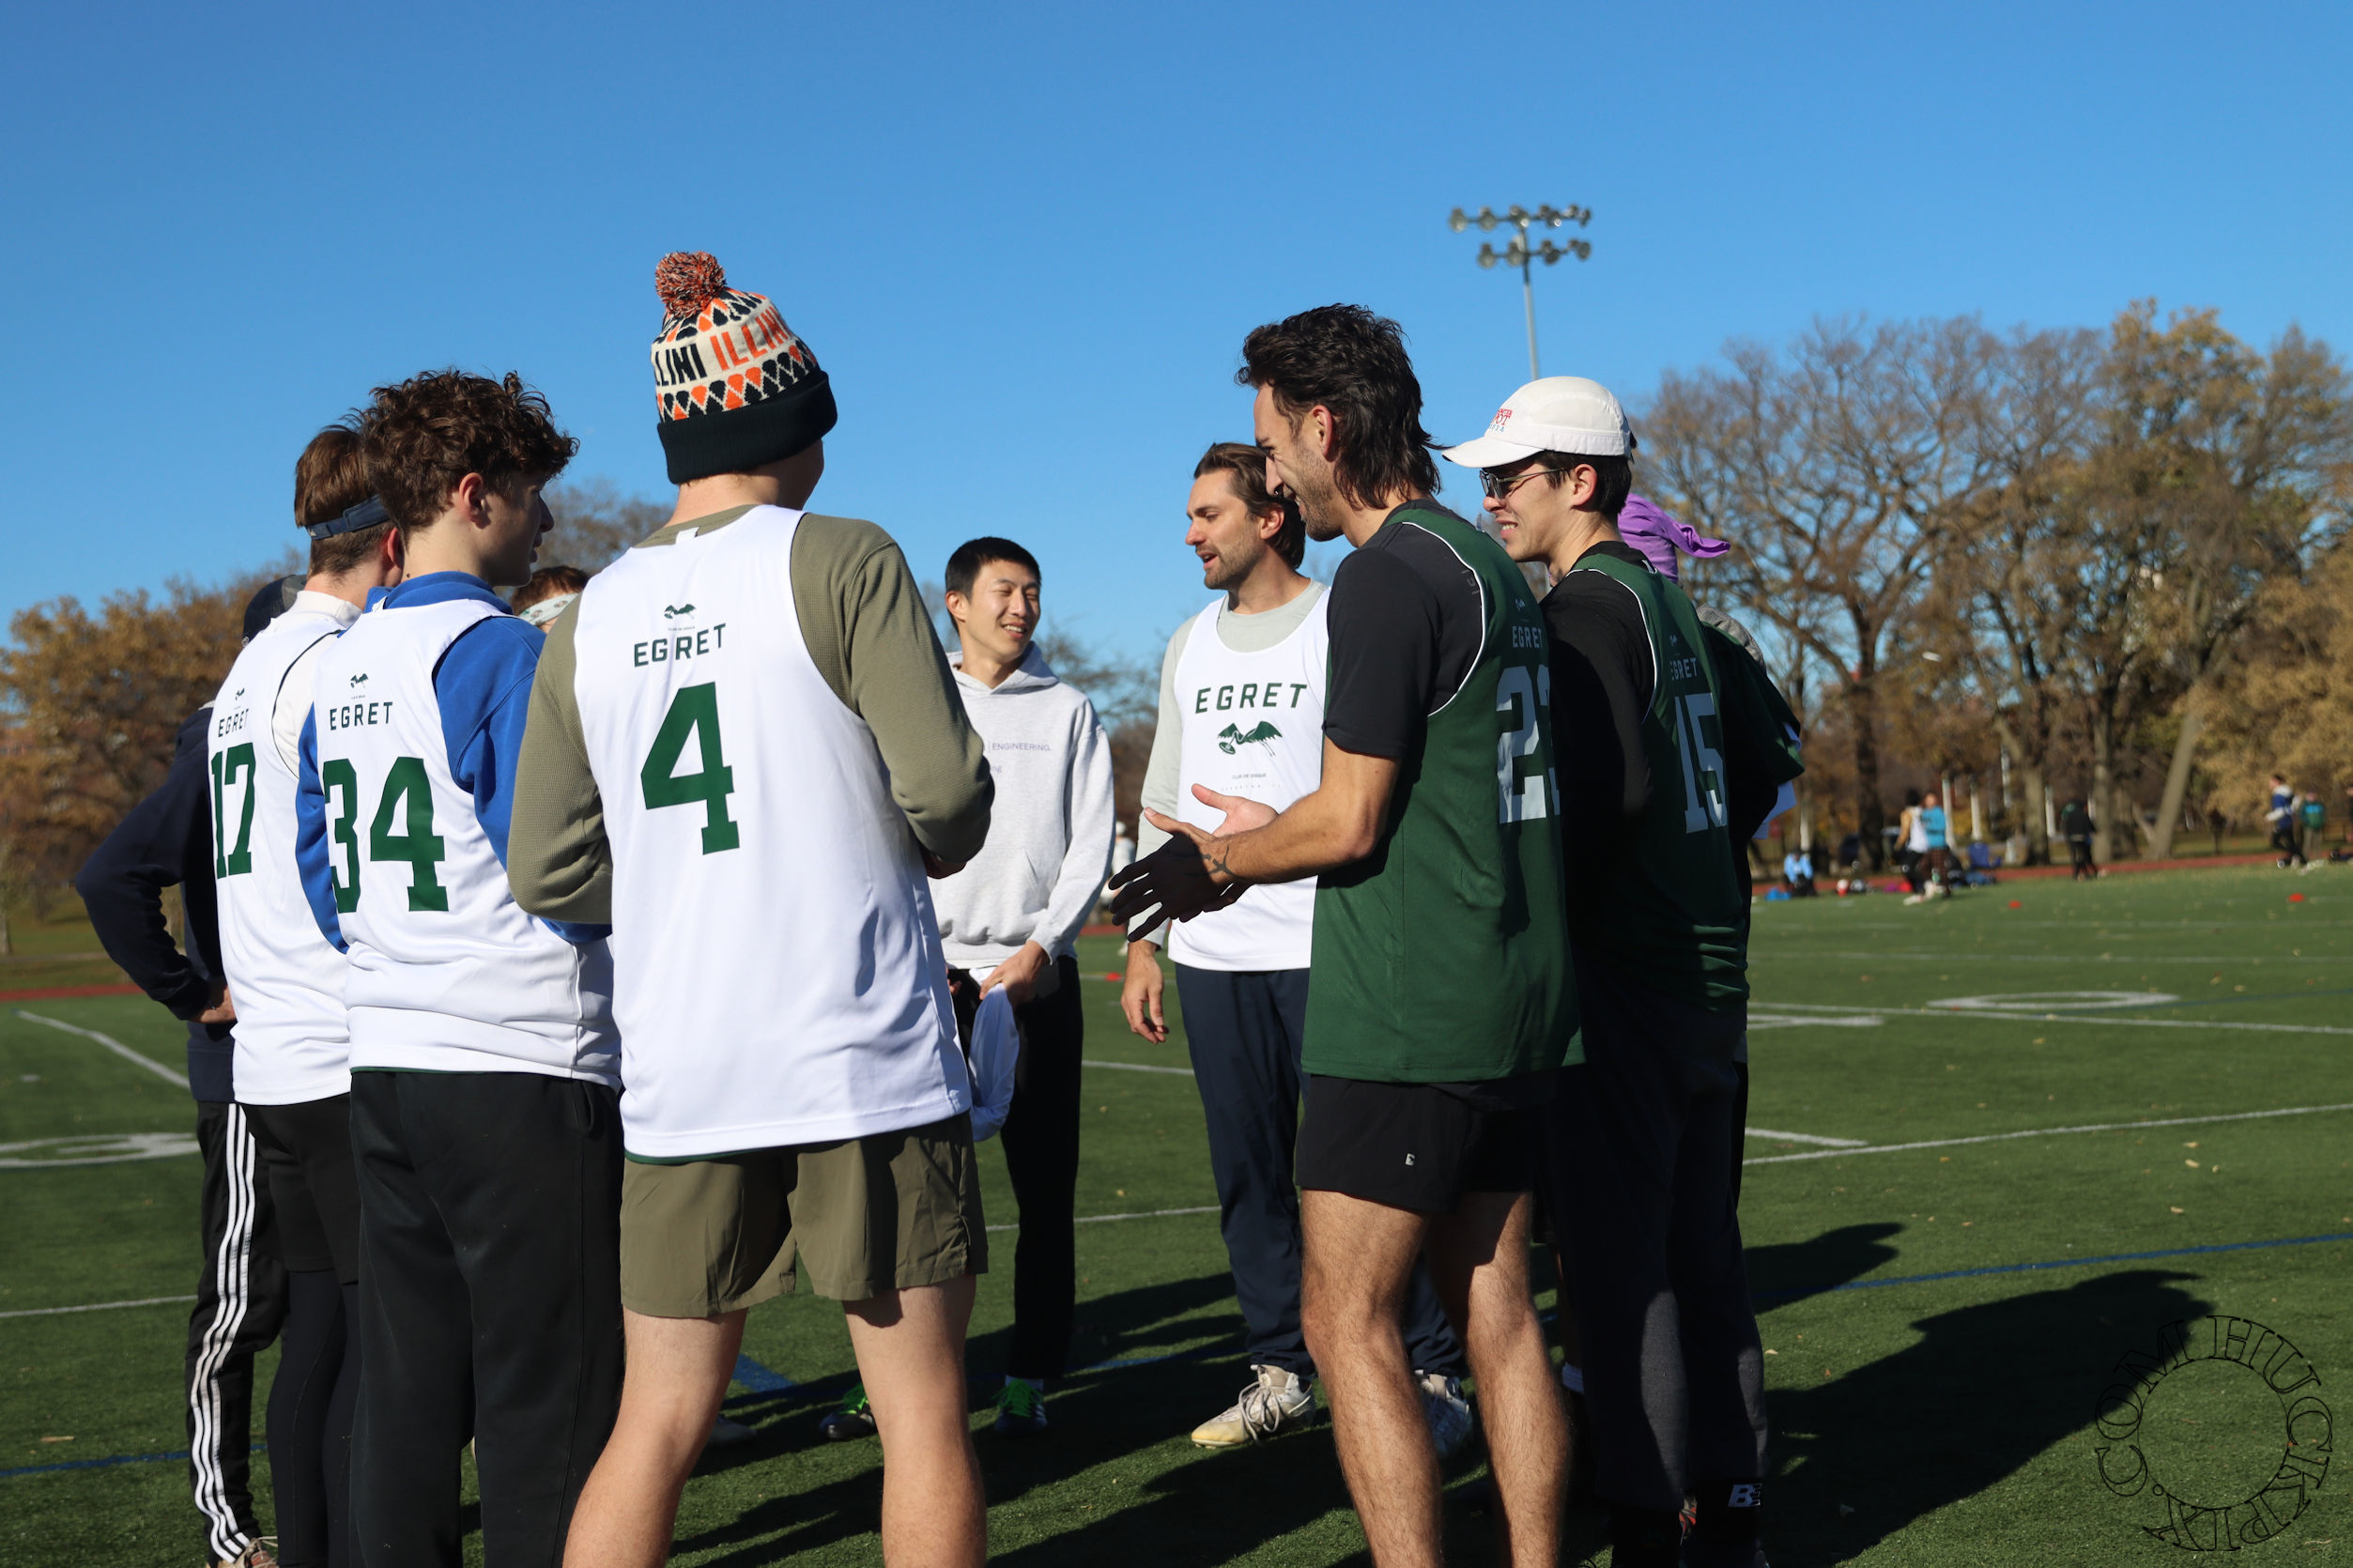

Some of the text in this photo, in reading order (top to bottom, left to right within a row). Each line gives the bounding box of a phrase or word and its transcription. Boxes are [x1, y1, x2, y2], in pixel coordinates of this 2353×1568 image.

[654, 306, 790, 386] LINI ILLINI
[634, 623, 726, 668] EGRET
[218, 708, 249, 738] EGRET
[330, 701, 393, 730] EGRET
[1195, 683, 1307, 714] EGRET
[640, 682, 740, 855] 4
[1675, 693, 1728, 834] 15
[211, 742, 255, 880] 17
[323, 757, 449, 913] 34
